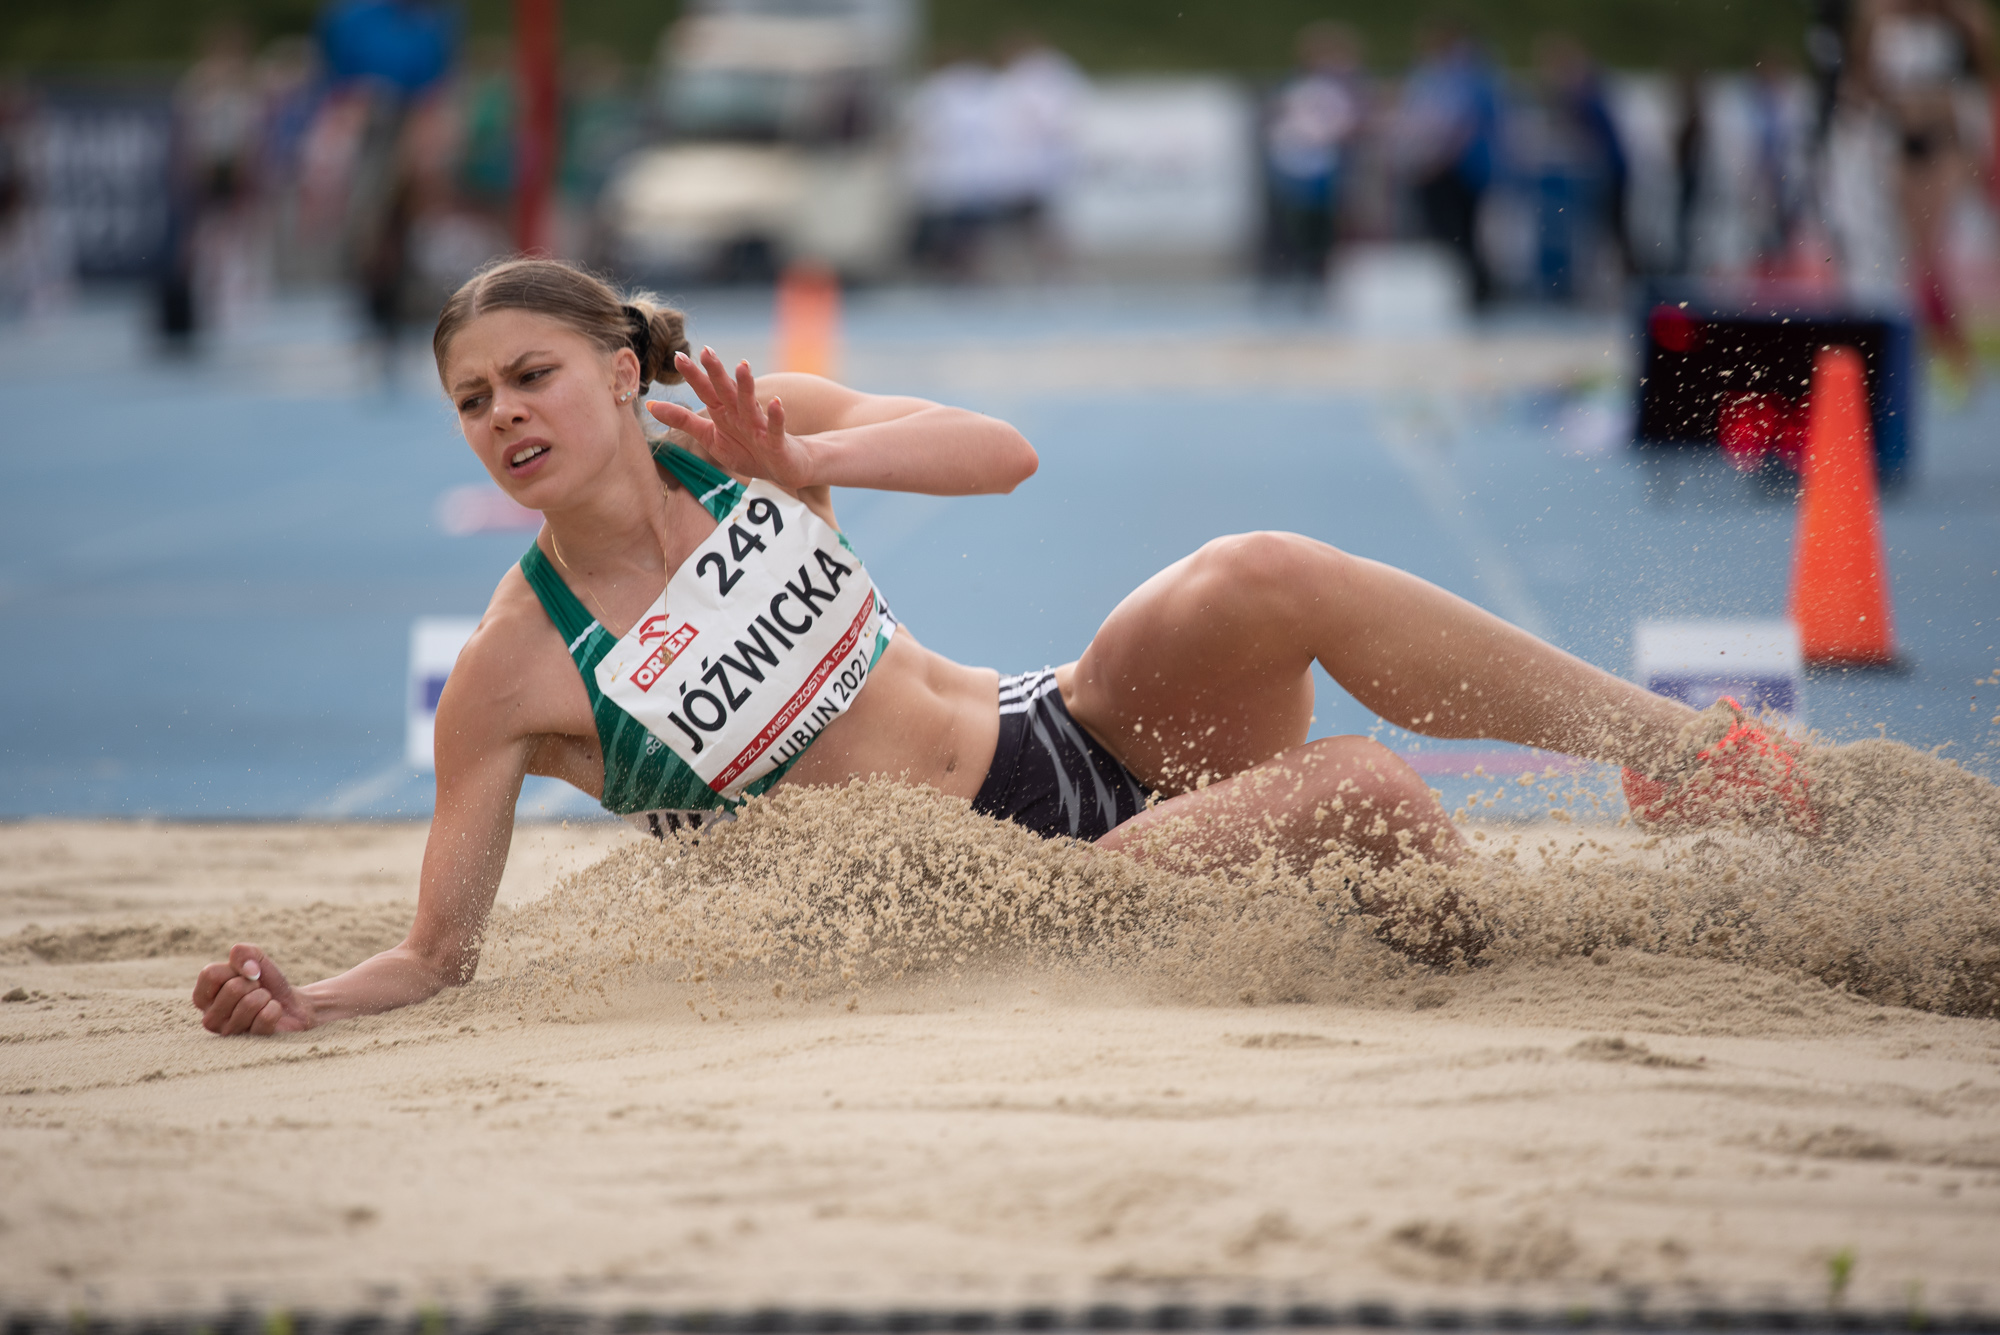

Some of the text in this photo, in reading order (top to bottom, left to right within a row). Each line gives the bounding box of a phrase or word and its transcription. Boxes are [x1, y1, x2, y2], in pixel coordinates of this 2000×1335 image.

[696, 497, 784, 597] 249
[667, 548, 853, 755] JÓŹWICKA
[720, 766, 739, 783] 75.
[738, 737, 769, 767] PZLA
[767, 659, 835, 738] MISTRZOSTWA
[832, 621, 860, 661] POLSKI
[833, 648, 869, 702] 2021
